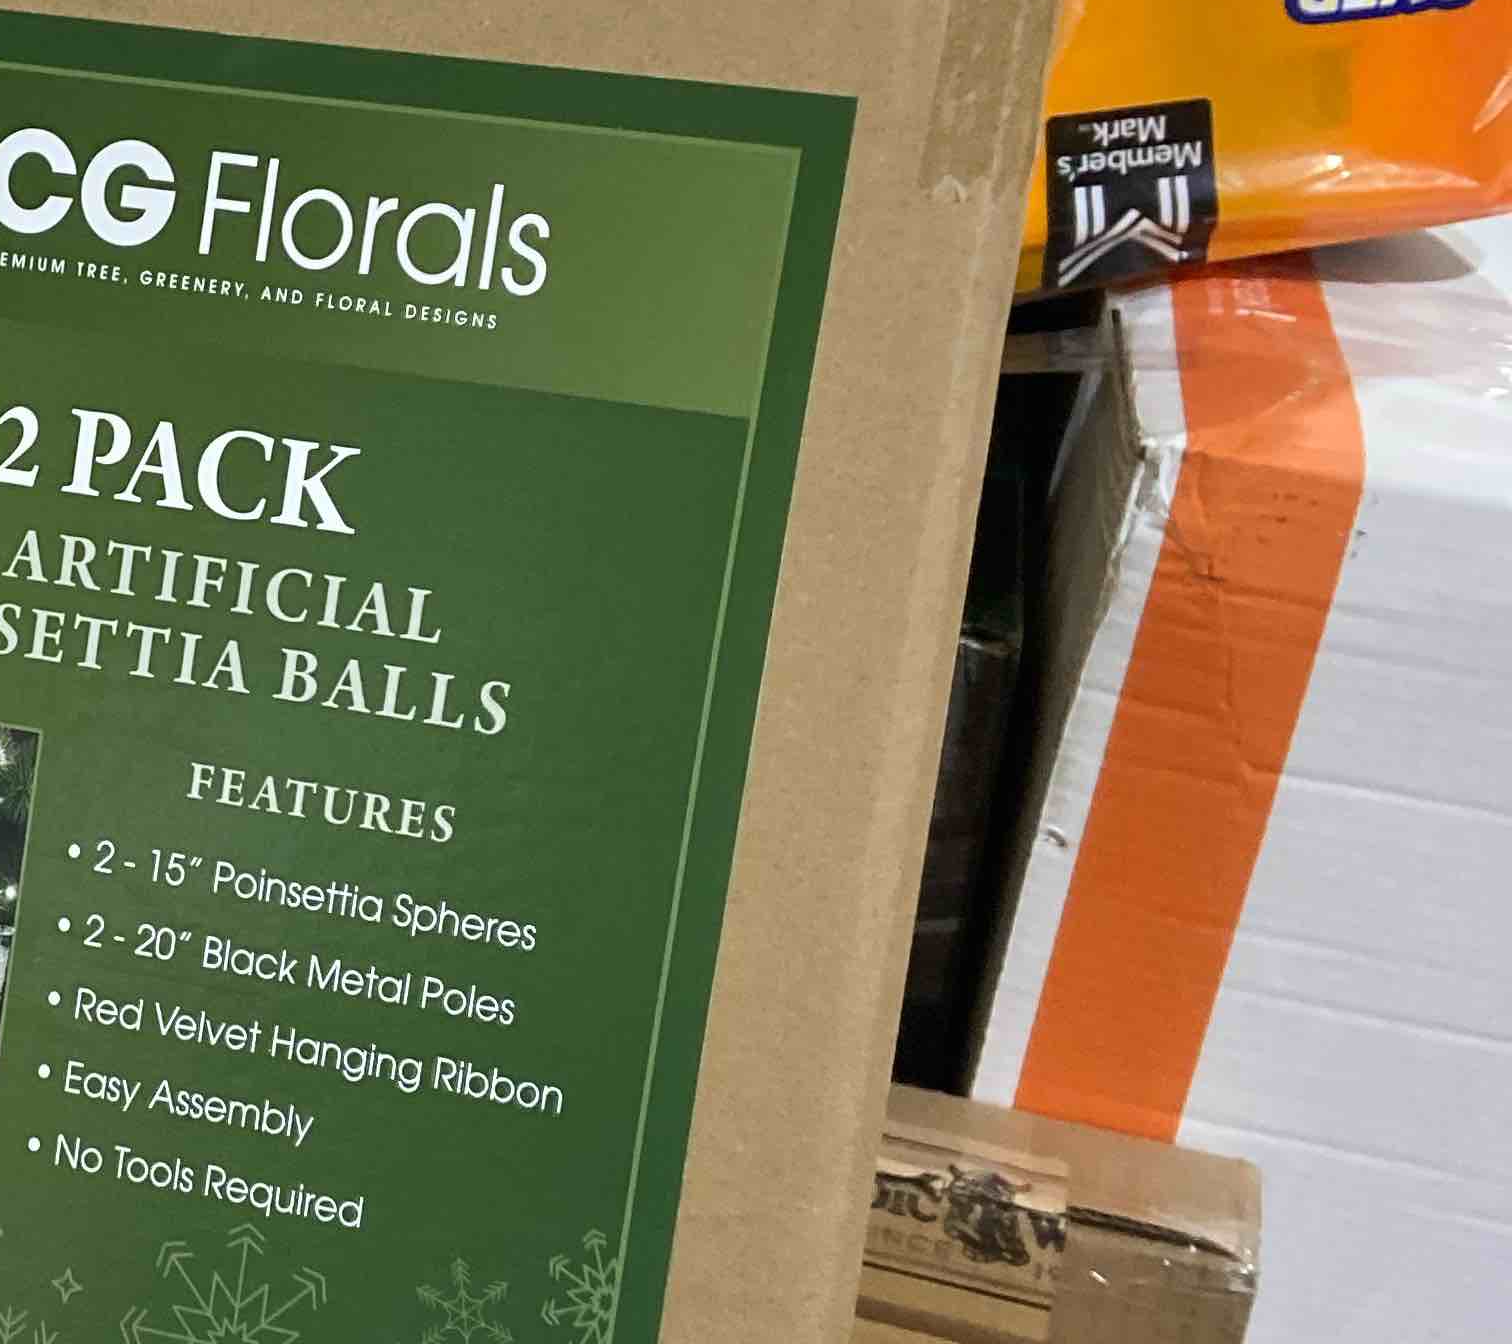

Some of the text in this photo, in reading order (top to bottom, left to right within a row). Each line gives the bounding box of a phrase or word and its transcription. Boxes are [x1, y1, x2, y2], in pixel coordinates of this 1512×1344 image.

[1057, 140, 1203, 182] Member's
[1092, 114, 1167, 147] Mark
[199, 152, 550, 296] Florals
[78, 262, 127, 283] TREE,
[140, 271, 248, 299] GREENERY,
[261, 287, 302, 304] AND
[316, 293, 392, 316] FLORAL
[406, 304, 496, 328] DESIGNS
[61, 409, 360, 534] PACK
[1, 531, 442, 645] ARTIFICIAL
[274, 648, 510, 734] BALLS
[187, 763, 455, 842] FEATURES
[94, 840, 114, 873] 2
[214, 861, 383, 922] Poinsettia
[393, 894, 536, 950] Spheres
[84, 915, 104, 947] 2
[203, 936, 297, 984] Black
[308, 955, 411, 1005] Metal
[422, 976, 514, 1024] Poles
[75, 988, 562, 1113] Red Velvet Hanging Ribbon
[64, 1061, 314, 1146] Easy Assembly
[55, 1134, 363, 1228] No Tools Required
